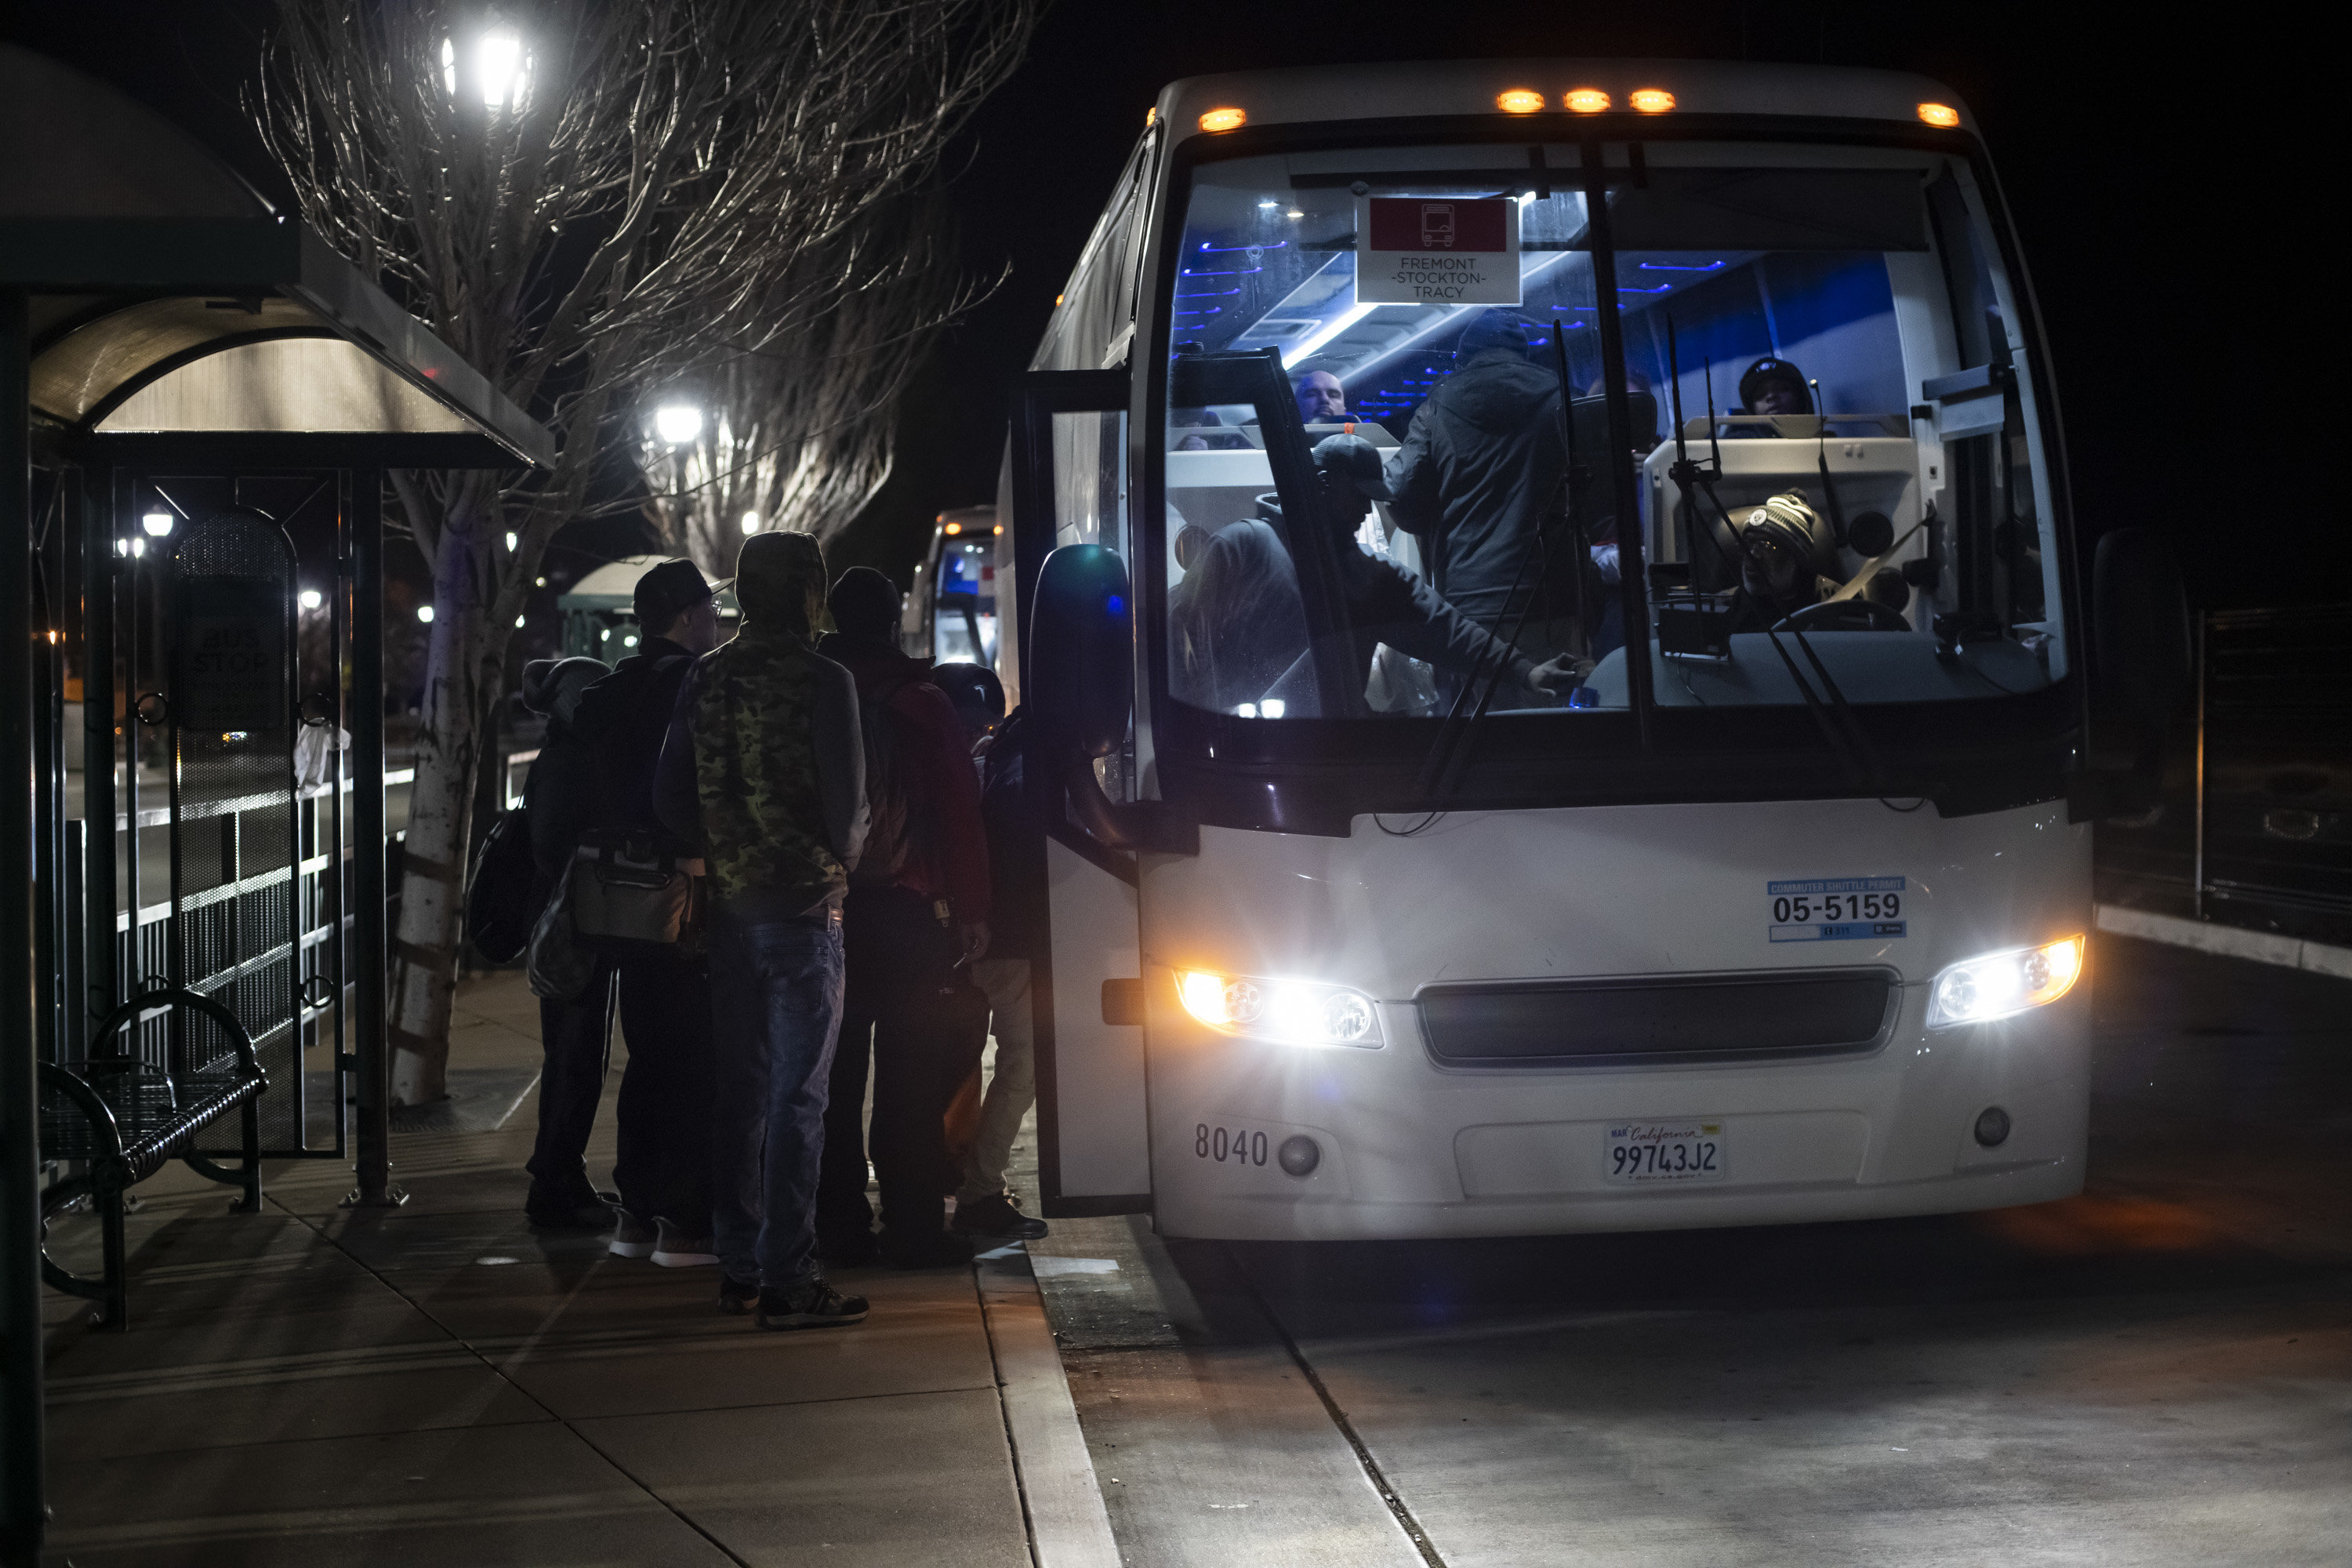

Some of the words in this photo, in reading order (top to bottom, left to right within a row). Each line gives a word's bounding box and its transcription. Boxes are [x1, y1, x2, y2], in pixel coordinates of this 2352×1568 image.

[1400, 257, 1476, 270] FREMONT
[1391, 271, 1486, 285] -STOCKTON-
[1414, 285, 1465, 299] TRACY
[193, 652, 270, 673] STOP
[1770, 883, 1824, 894] COMMUTER
[1826, 880, 1865, 892] SHUTTLE
[1867, 879, 1902, 891] PERMIT
[1773, 892, 1900, 923] 05-5159
[1611, 1129, 1628, 1138] MAR
[1631, 1127, 1699, 1144] California
[1196, 1123, 1268, 1167] 8040
[1613, 1142, 1717, 1175] 99743J2
